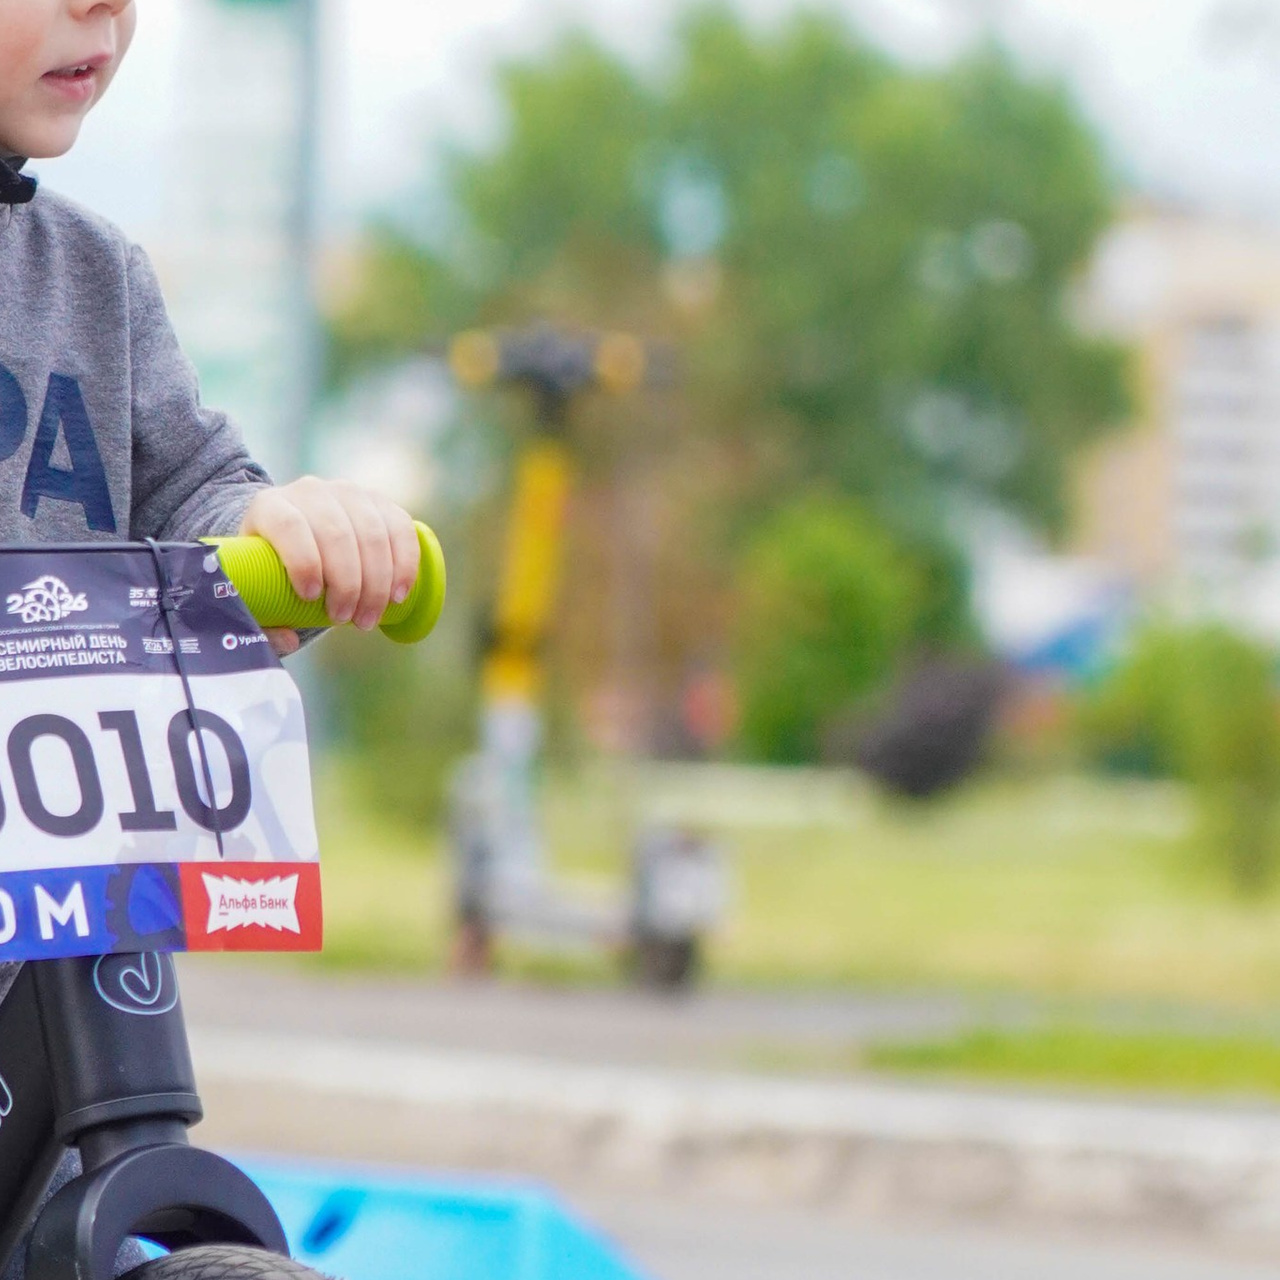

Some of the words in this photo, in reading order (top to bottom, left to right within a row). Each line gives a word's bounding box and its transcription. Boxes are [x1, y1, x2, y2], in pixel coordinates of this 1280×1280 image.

[88, 634, 128, 650] ДЕНЬ
[219, 894, 257, 913] Альфа
[259, 894, 289, 910] Банк
